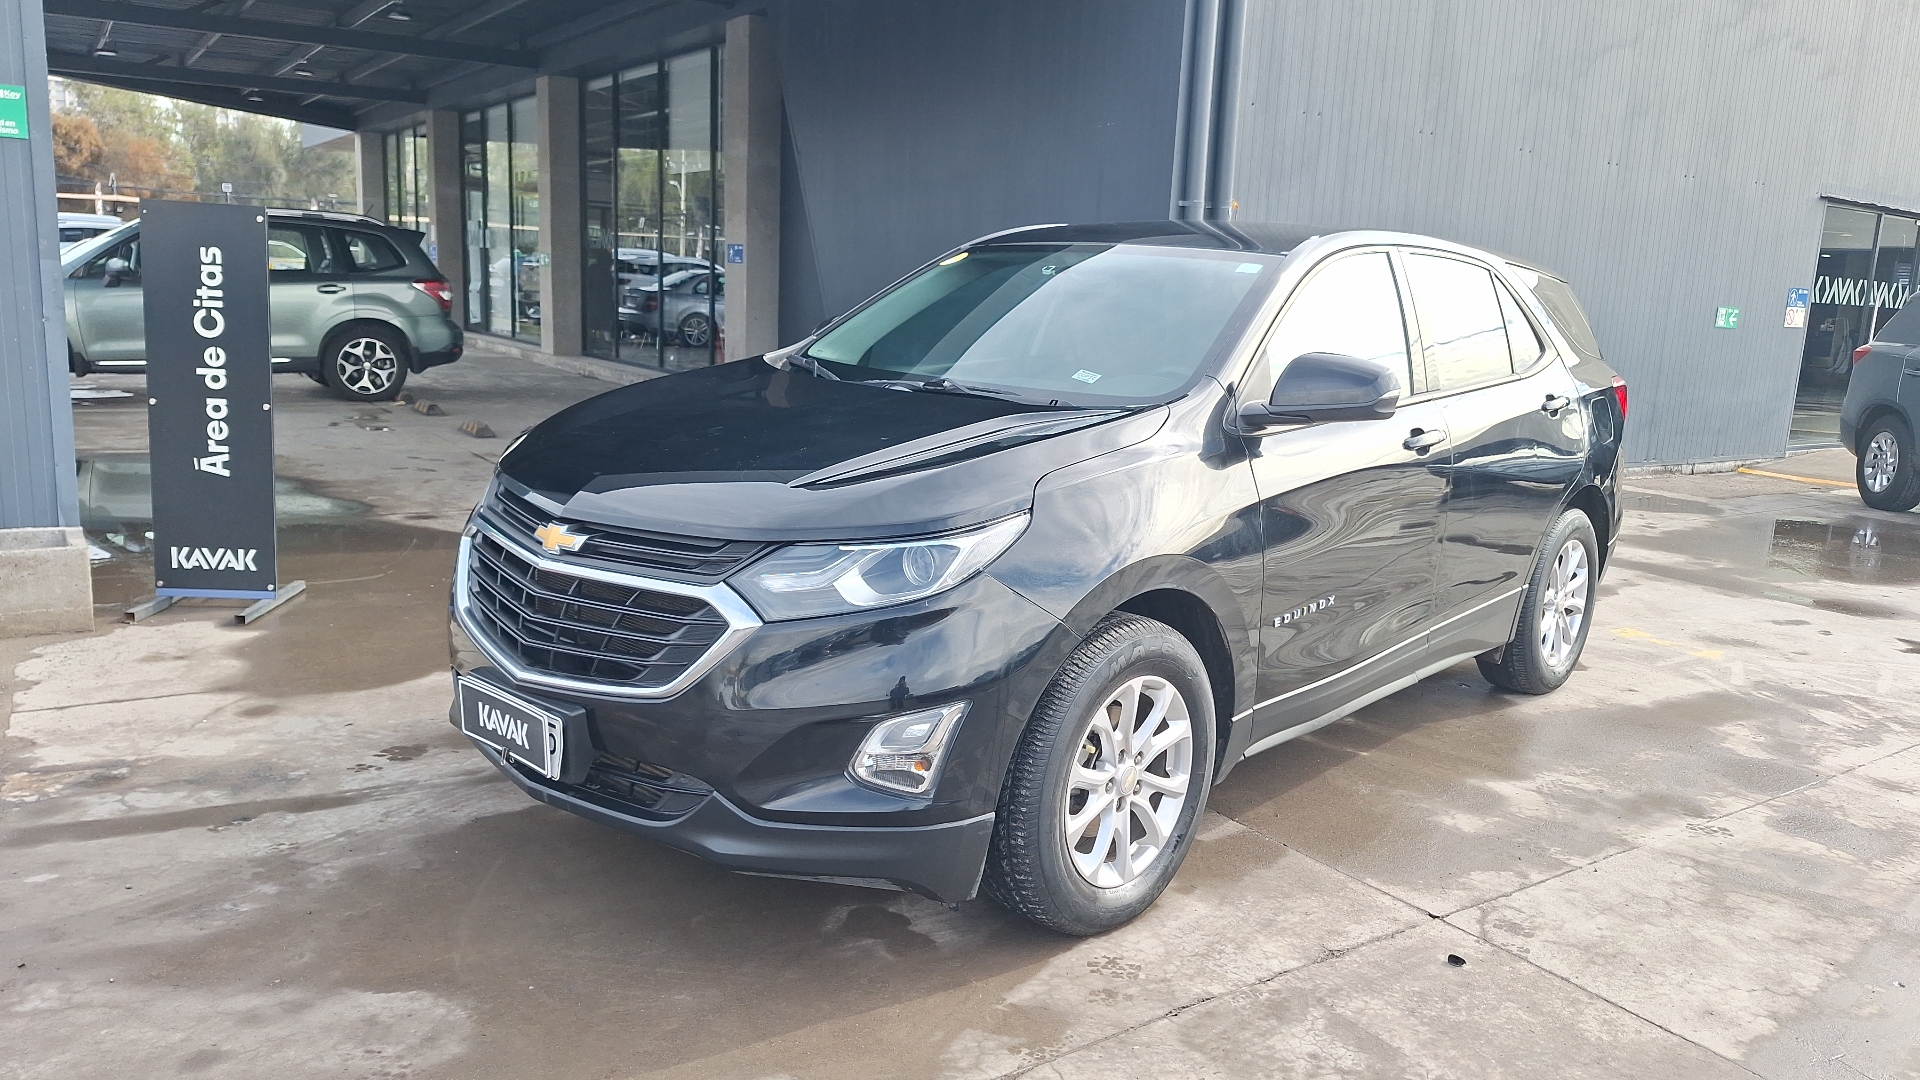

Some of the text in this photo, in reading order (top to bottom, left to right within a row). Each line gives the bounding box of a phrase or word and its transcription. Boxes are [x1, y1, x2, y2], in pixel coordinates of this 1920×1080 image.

[0, 126, 19, 135] ismo
[193, 246, 231, 478] Área de Citas
[170, 546, 258, 572] KAVAK
[1273, 594, 1336, 628] EQUINOX
[477, 701, 530, 750] KAVAK
